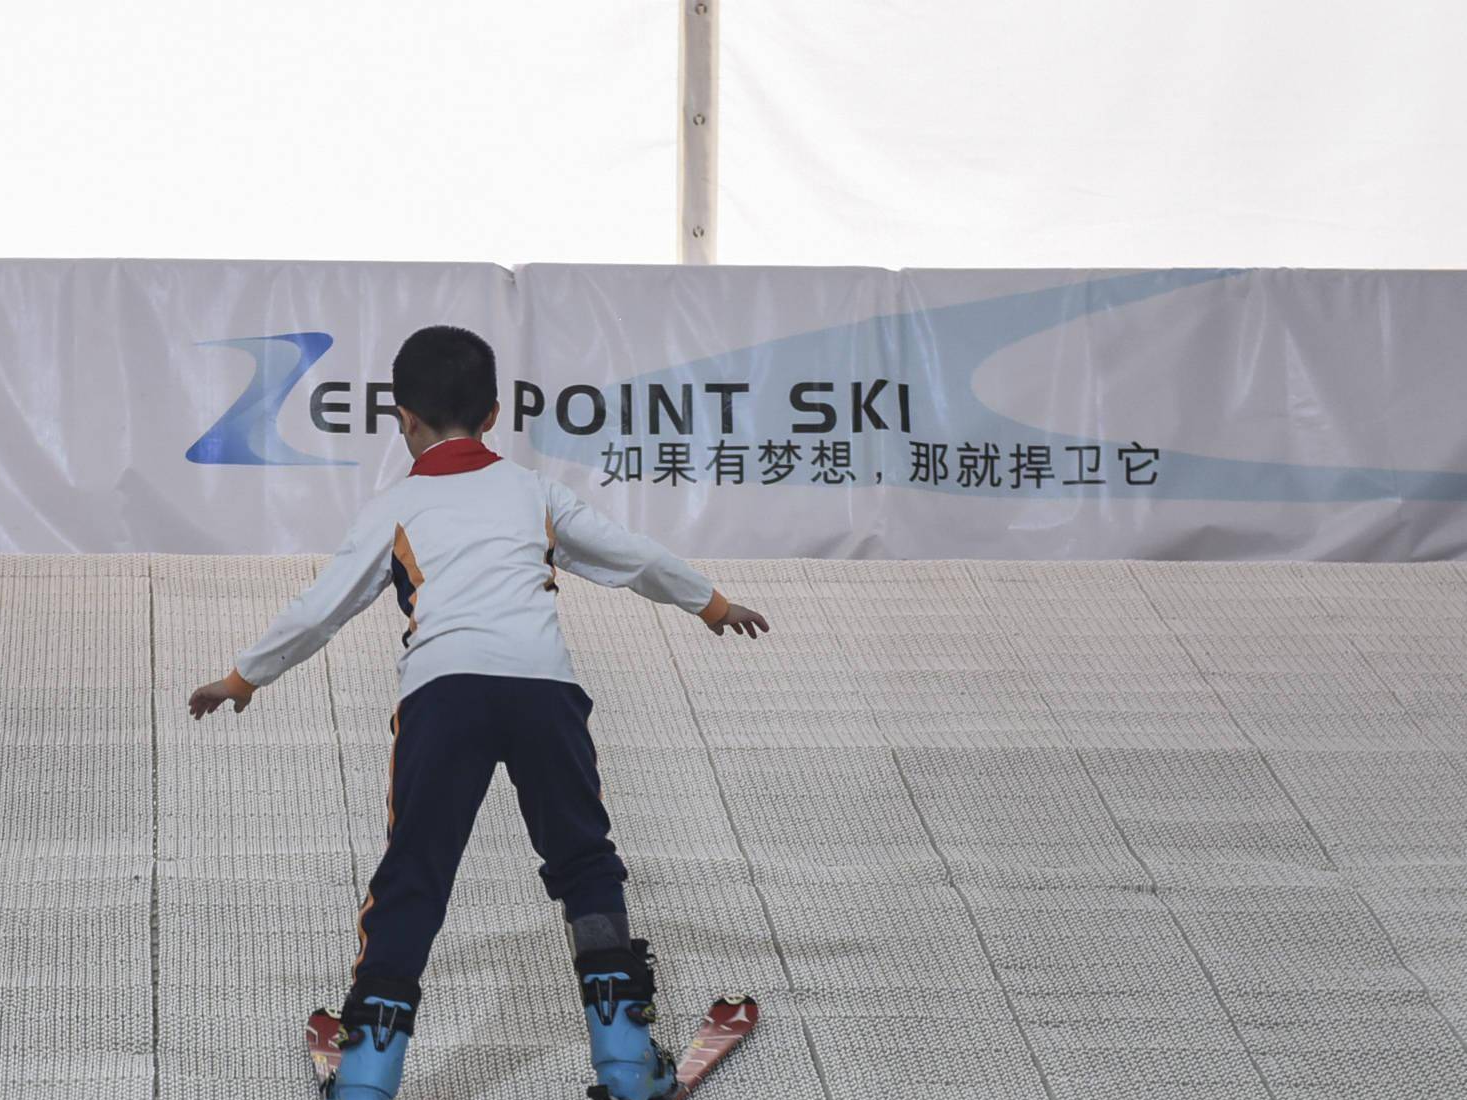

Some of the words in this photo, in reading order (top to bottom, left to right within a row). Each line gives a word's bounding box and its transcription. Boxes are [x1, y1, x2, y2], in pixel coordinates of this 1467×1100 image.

[512, 379, 750, 436] POINT
[788, 378, 912, 434] SKI
[599, 438, 1161, 489] 如果有梦想，那就捍卫它
